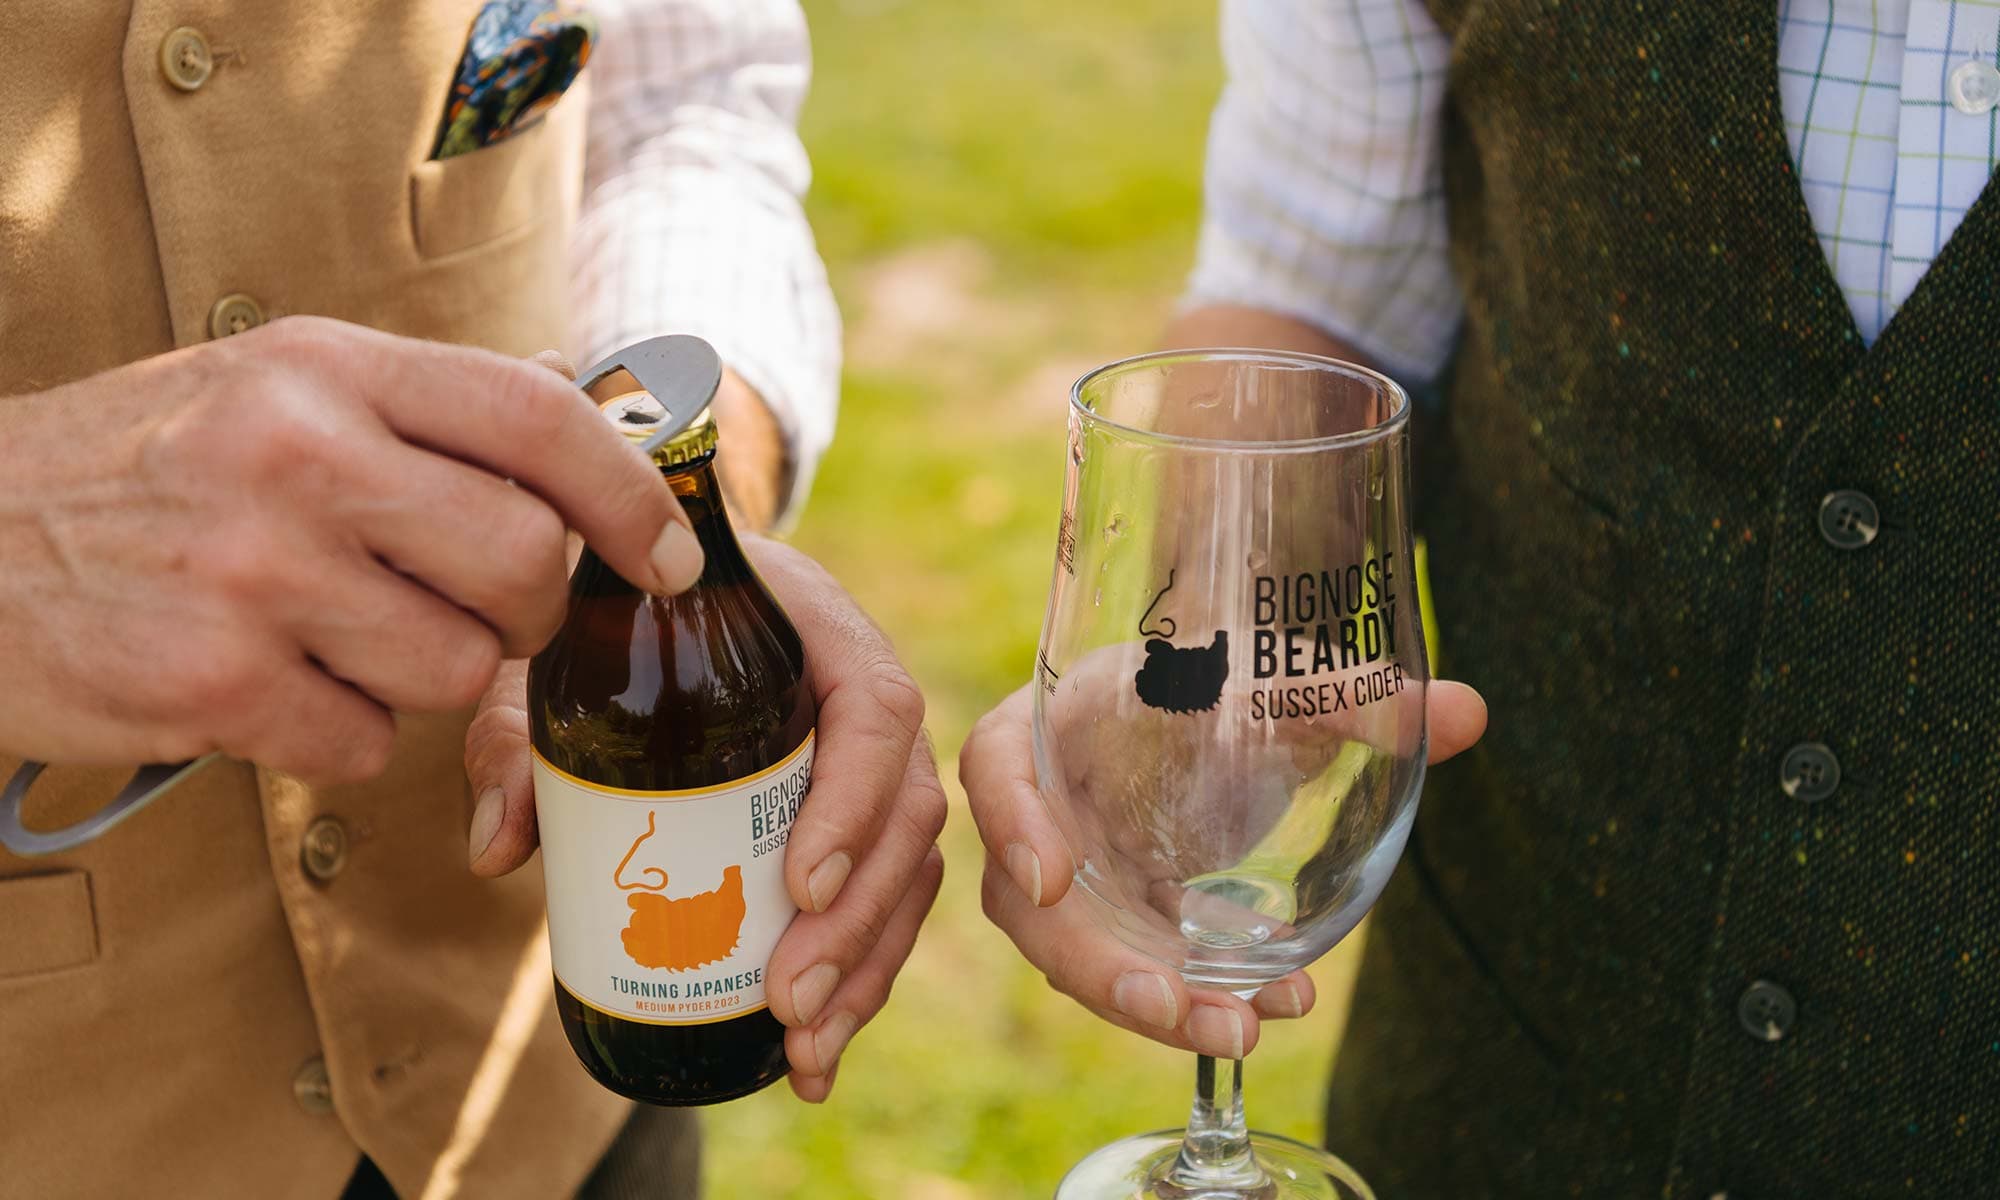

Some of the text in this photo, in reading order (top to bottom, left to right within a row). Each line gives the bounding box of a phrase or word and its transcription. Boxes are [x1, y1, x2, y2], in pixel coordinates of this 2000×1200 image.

[1253, 552, 1396, 626] BIGNOSE
[1253, 603, 1397, 679] BEARDY
[1251, 662, 1404, 720] SUSSEX CIDER
[751, 758, 811, 818] BIGNOSE
[611, 968, 762, 999] TURNING JAPANESE
[635, 995, 740, 1013] MEDIUM PYDER 2023
